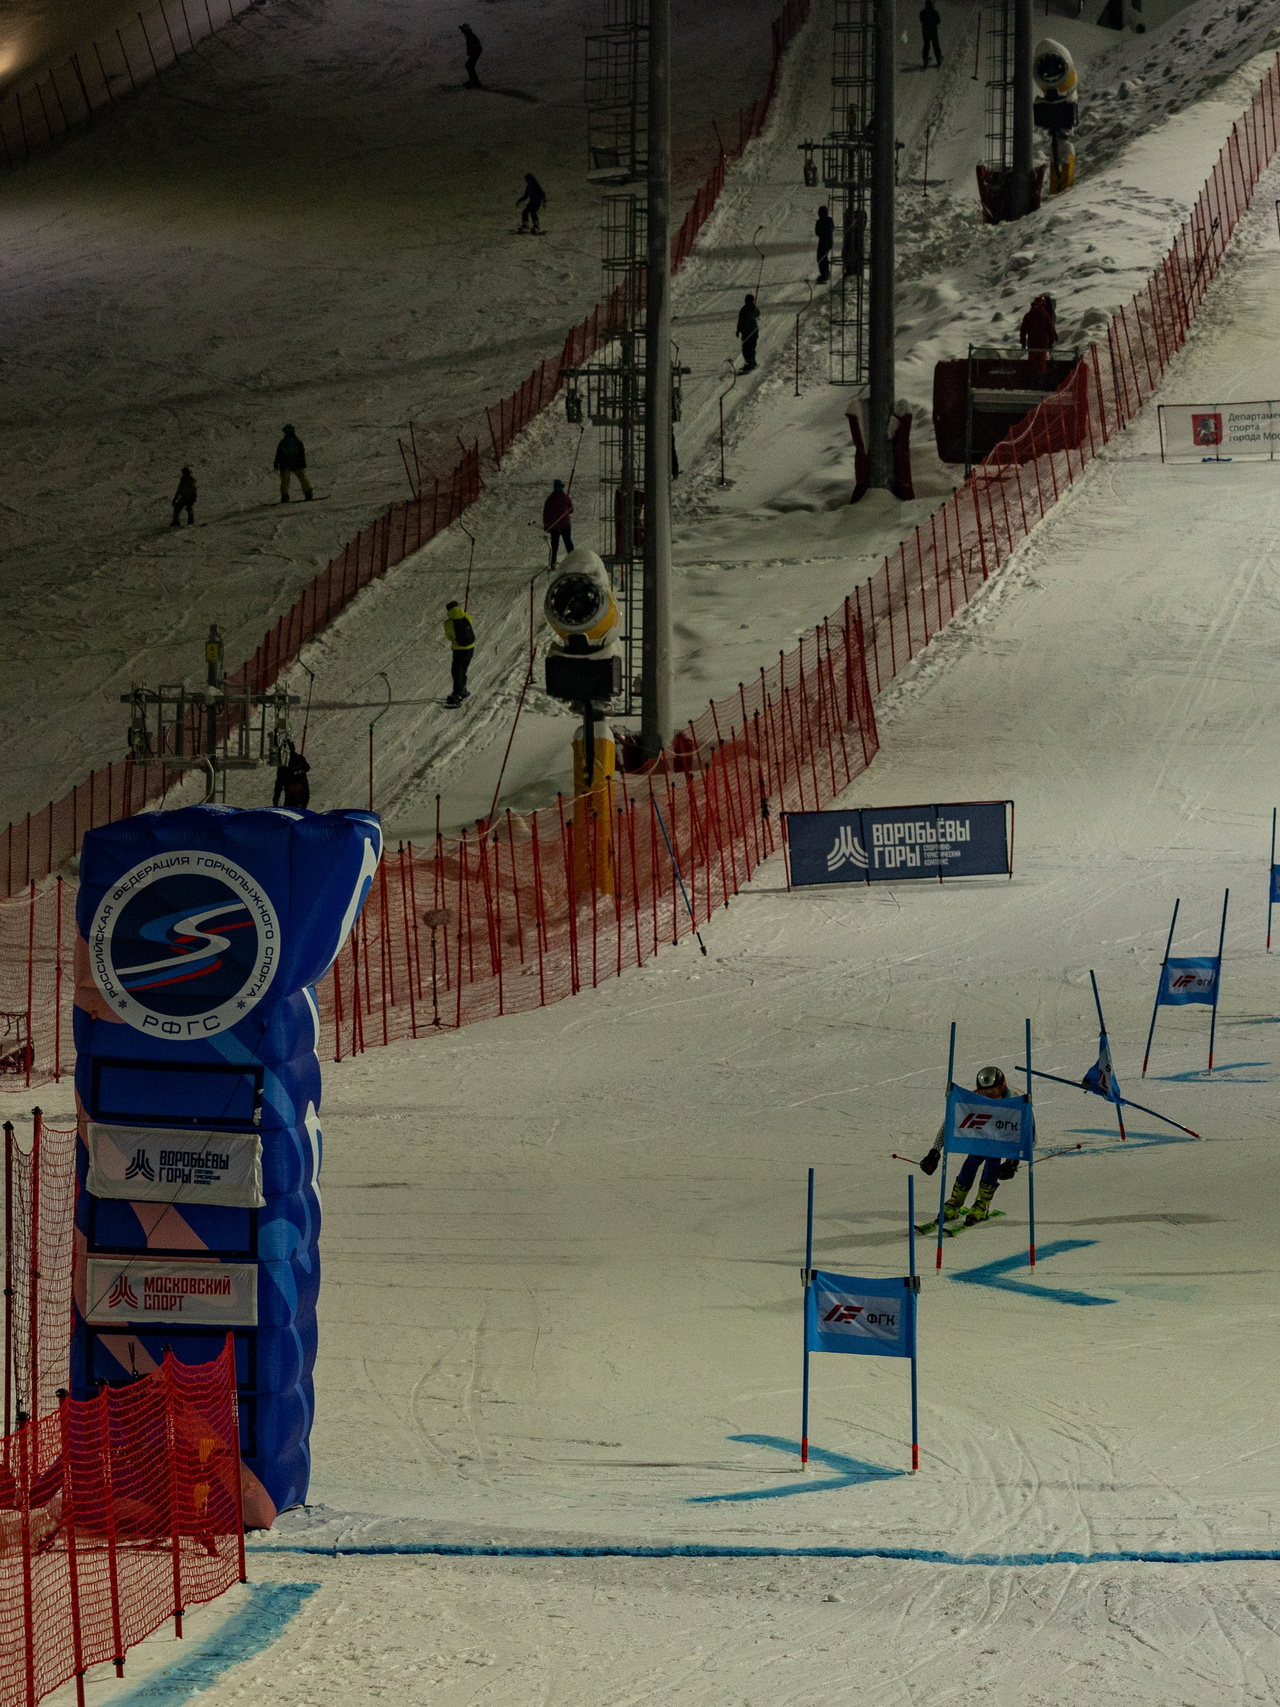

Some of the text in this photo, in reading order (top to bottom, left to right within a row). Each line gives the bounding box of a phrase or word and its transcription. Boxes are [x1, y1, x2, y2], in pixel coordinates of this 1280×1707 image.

[1229, 424, 1260, 432] спорта
[1229, 433, 1261, 442] города
[872, 818, 971, 846] ВОРОБЬЁВЫ
[873, 845, 921, 869] ГОРЫ
[94, 856, 274, 999] РОССИЙСКАЯ ФЕДЕРАЦИЯ ГОРНОЛЫЖНОГО СПОРТА
[1197, 975, 1213, 986] ФГК
[142, 1014, 221, 1035] РФГС
[995, 1120, 1018, 1131] ФГК
[159, 1150, 230, 1170] ВОРОБЬЁВЫ
[159, 1167, 192, 1184] ГОРЫ
[144, 1275, 231, 1295] МОСКОВСКИЙ
[144, 1294, 185, 1311] СПОРТ
[866, 1313, 895, 1326] ФГК
